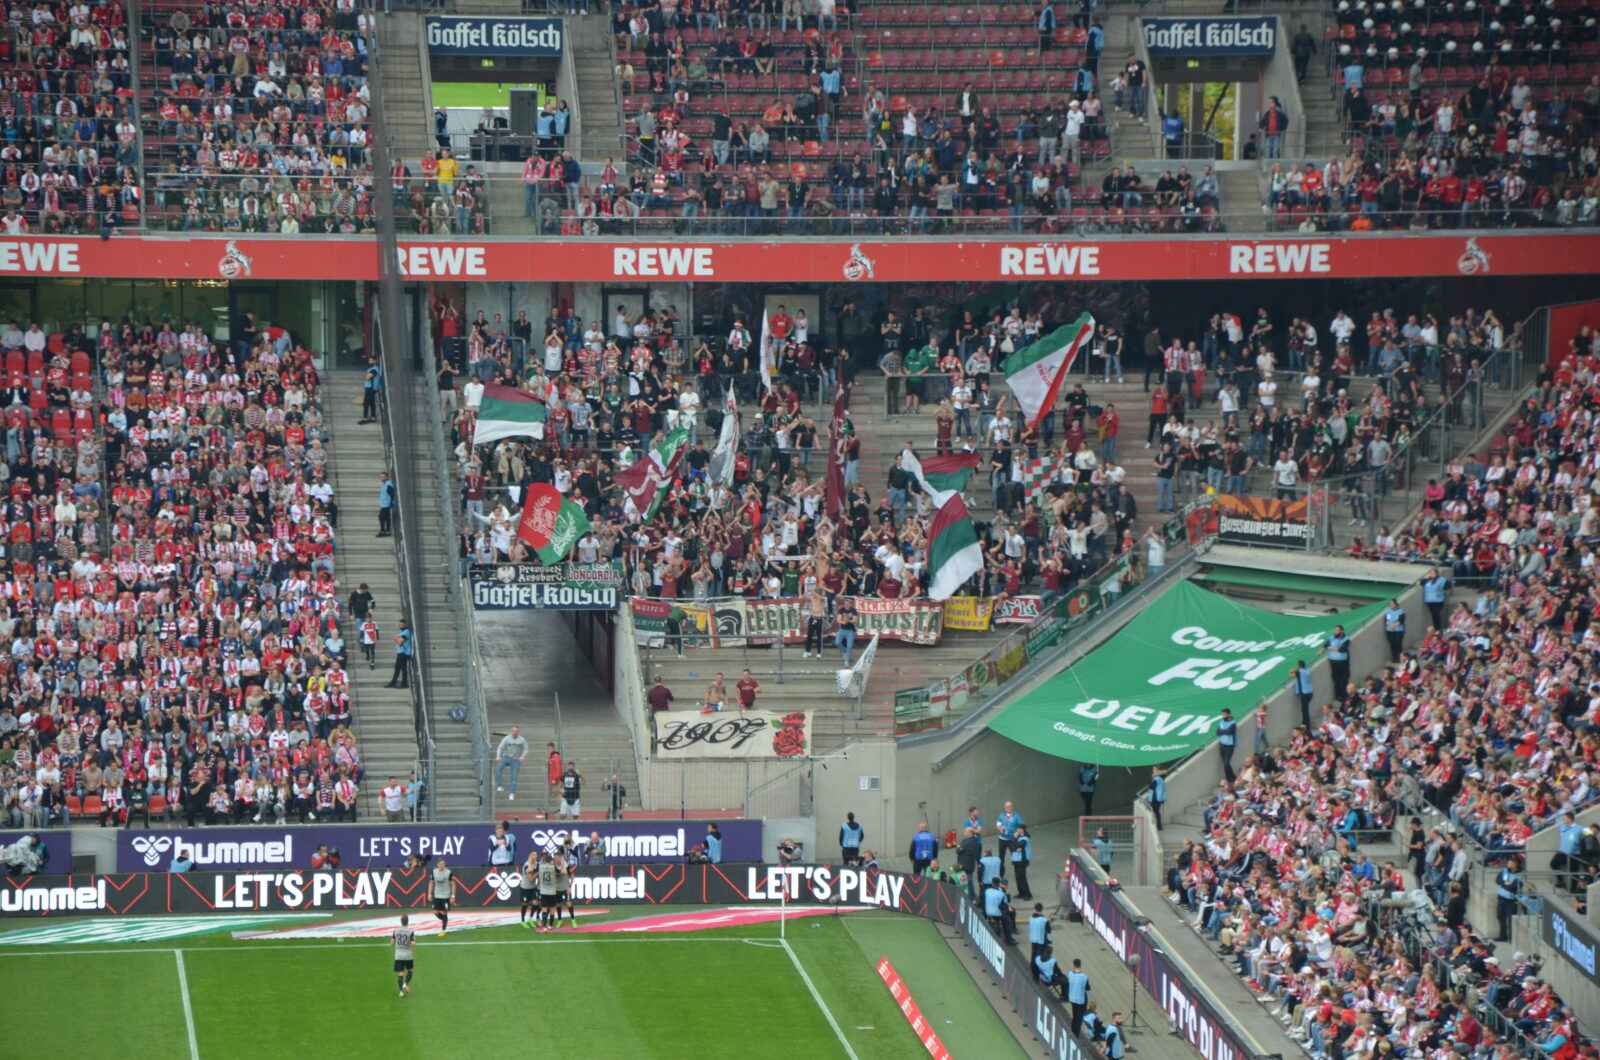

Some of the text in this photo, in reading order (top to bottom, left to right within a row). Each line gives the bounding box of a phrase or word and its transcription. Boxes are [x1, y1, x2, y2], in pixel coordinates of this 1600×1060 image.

[428, 22, 560, 51] Gaffel Kölsch
[1206, 22, 1274, 49] Kölsch
[0, 242, 80, 272] EWE
[614, 247, 714, 276] REWE
[1001, 246, 1100, 275] REWE
[1230, 244, 1330, 273] REWE
[1171, 626, 1276, 653] Come
[1148, 655, 1286, 690] FC!
[1053, 721, 1096, 742] Gesagt.
[1070, 698, 1224, 736] DEVK
[174, 834, 293, 865] hummel
[419, 836, 465, 856] PLAY
[0, 879, 106, 912] ummel
[215, 871, 392, 909] LET'S PLAY
[570, 869, 646, 900] mmel
[748, 866, 905, 909] LET'S PLAY
[396, 933, 409, 946] 32
